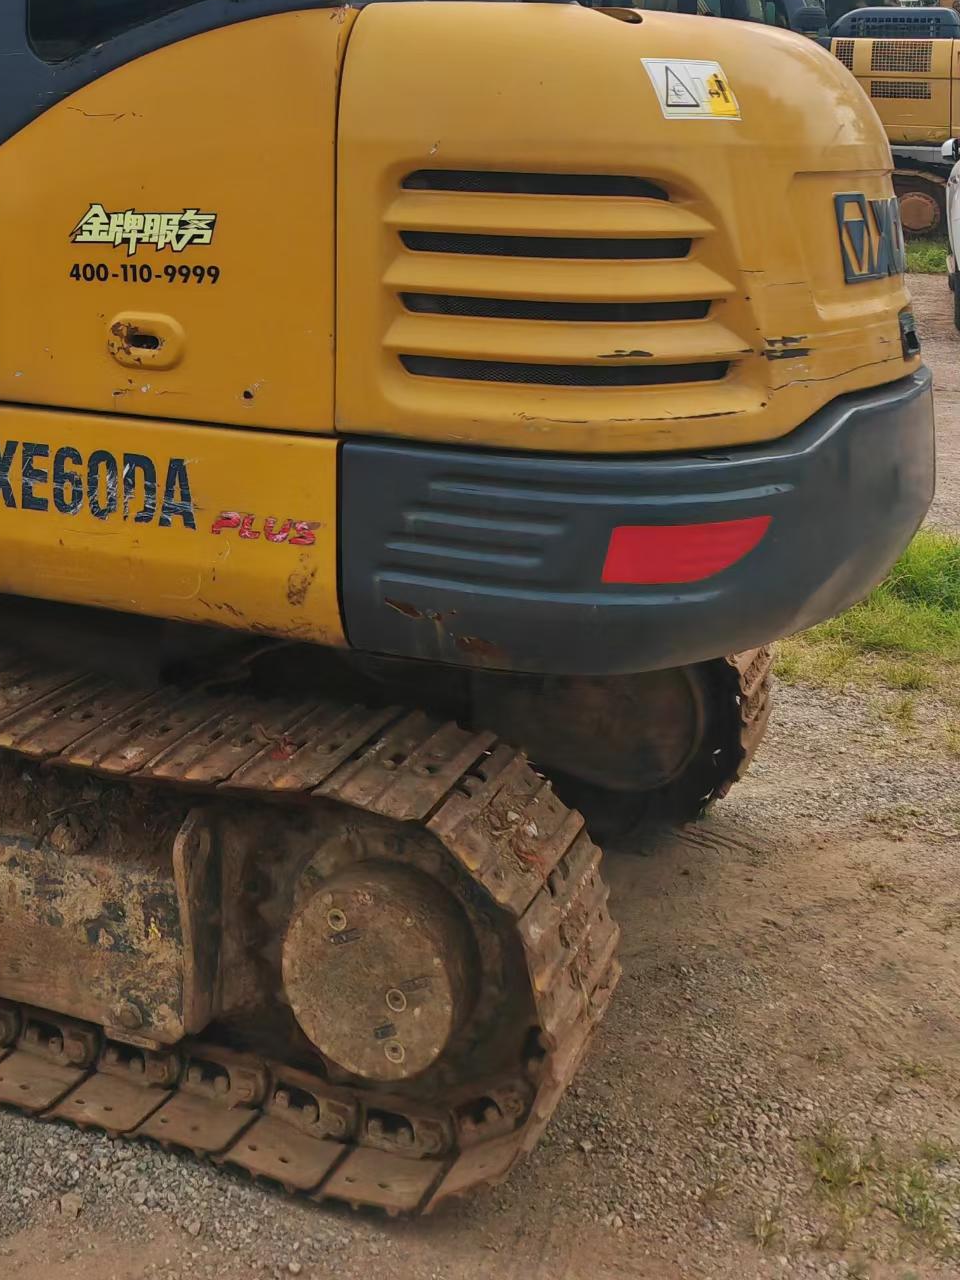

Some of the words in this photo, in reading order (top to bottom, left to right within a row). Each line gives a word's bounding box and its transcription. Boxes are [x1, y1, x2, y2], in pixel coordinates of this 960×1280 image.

[69, 204, 217, 257] 金牌服务
[69, 263, 220, 284] 400-110-9999
[210, 511, 318, 546] PLUS
